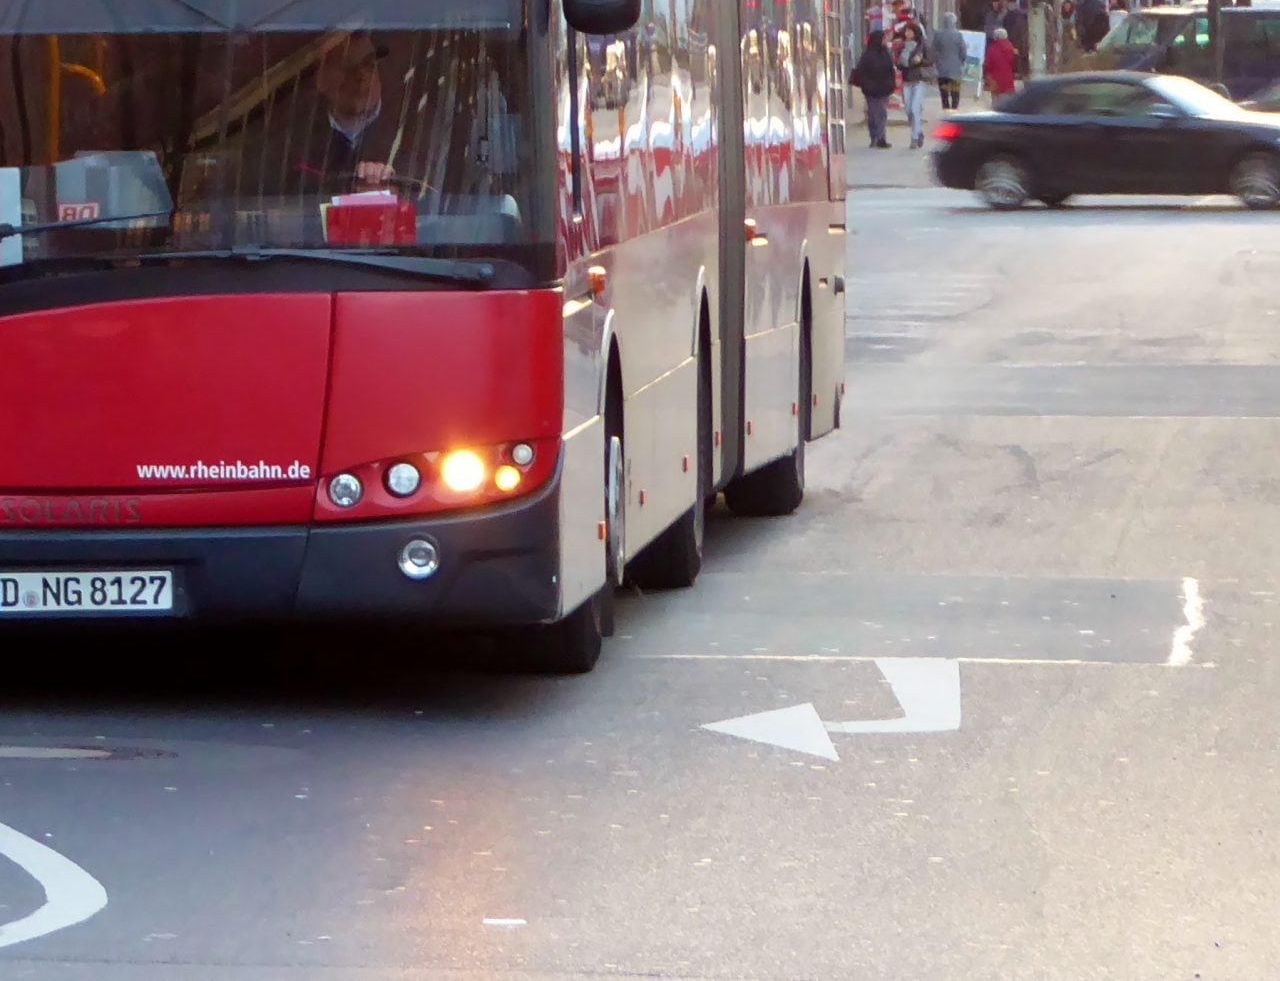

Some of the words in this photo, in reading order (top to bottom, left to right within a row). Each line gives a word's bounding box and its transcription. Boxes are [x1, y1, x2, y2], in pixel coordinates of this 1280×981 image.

[137, 460, 311, 479] www.rheinbahn.de
[0, 497, 142, 523] SOLARIS
[0, 578, 19, 607] D
[42, 577, 83, 606] NG
[90, 575, 167, 605] 8127
